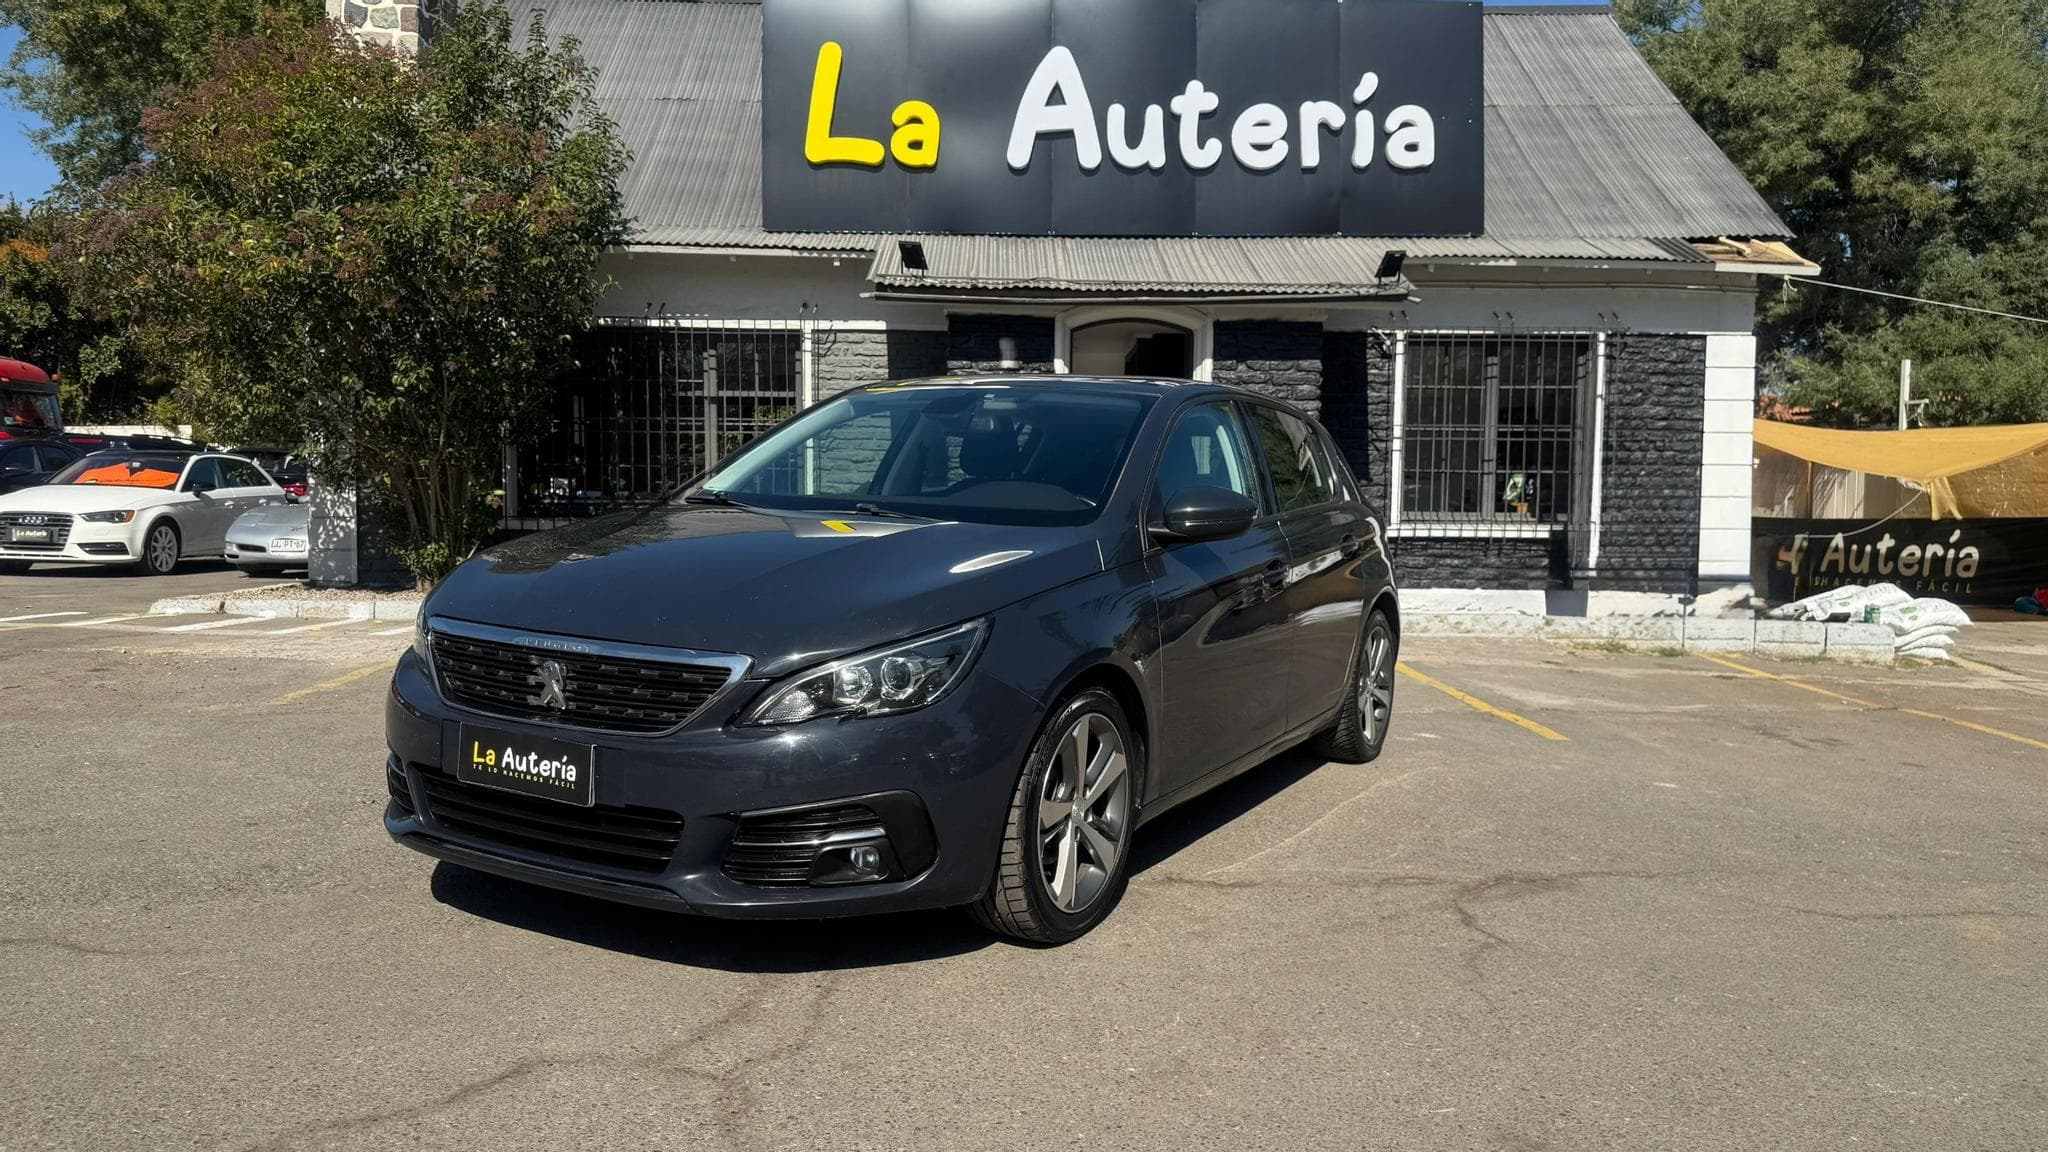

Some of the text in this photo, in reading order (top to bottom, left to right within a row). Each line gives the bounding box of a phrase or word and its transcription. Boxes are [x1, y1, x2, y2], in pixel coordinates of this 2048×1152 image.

[804, 41, 1436, 169] La Autería
[1819, 528, 1980, 579] Autería
[1916, 579, 1973, 593] FÁCIL
[473, 741, 577, 782] La Autería
[473, 763, 482, 771] TE
